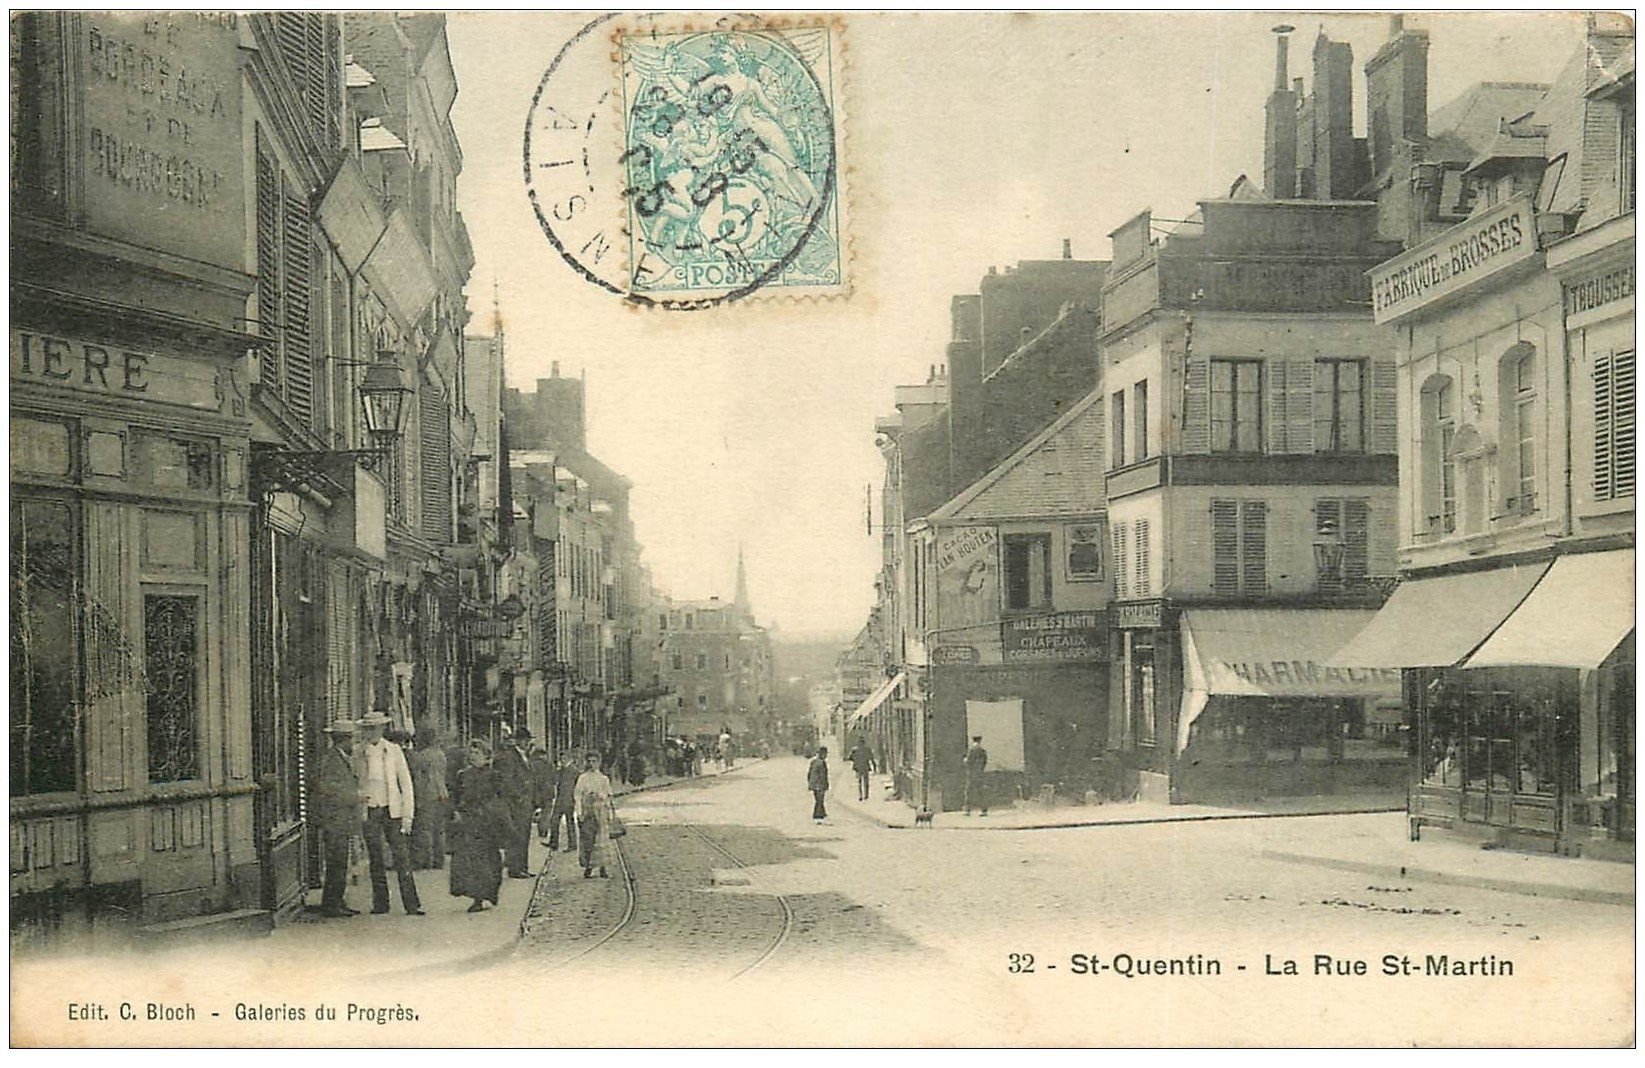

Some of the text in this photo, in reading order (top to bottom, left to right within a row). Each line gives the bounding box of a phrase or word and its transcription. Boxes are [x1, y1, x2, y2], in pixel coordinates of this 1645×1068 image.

[540, 105, 654, 291] AISNE
[1375, 253, 1440, 312] FABRIQUE
[1449, 212, 1523, 277] BROSSES
[943, 527, 977, 551] CACAO
[957, 530, 993, 558] HOUTEN
[1019, 634, 1088, 651] CHAPEAUX
